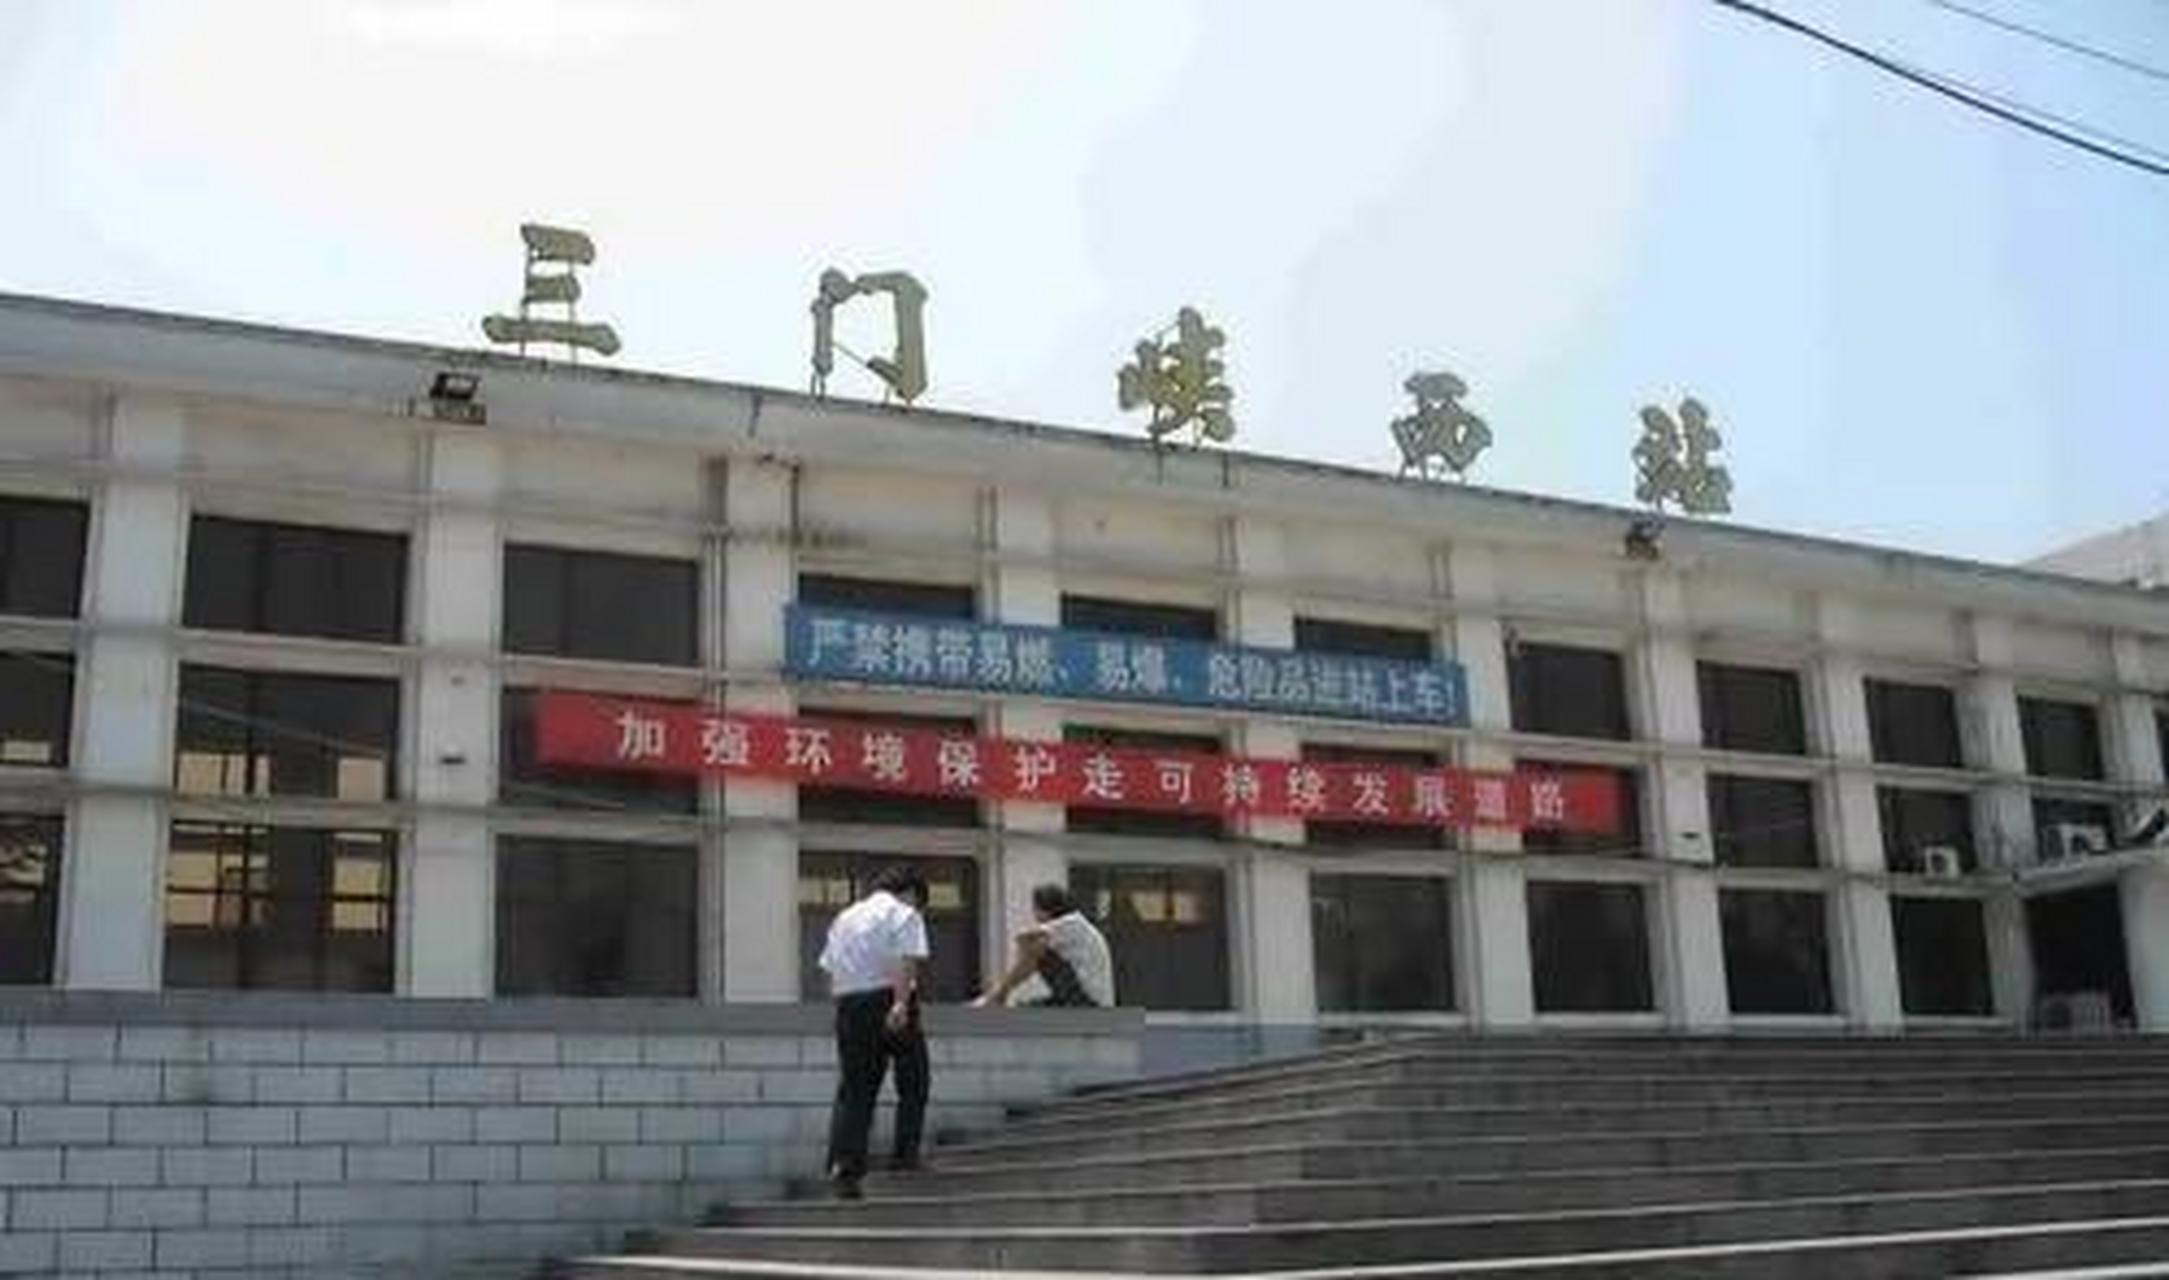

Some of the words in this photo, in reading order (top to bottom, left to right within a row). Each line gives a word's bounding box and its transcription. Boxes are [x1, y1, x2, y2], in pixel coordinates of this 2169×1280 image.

[484, 223, 1732, 514] 三门峡西站
